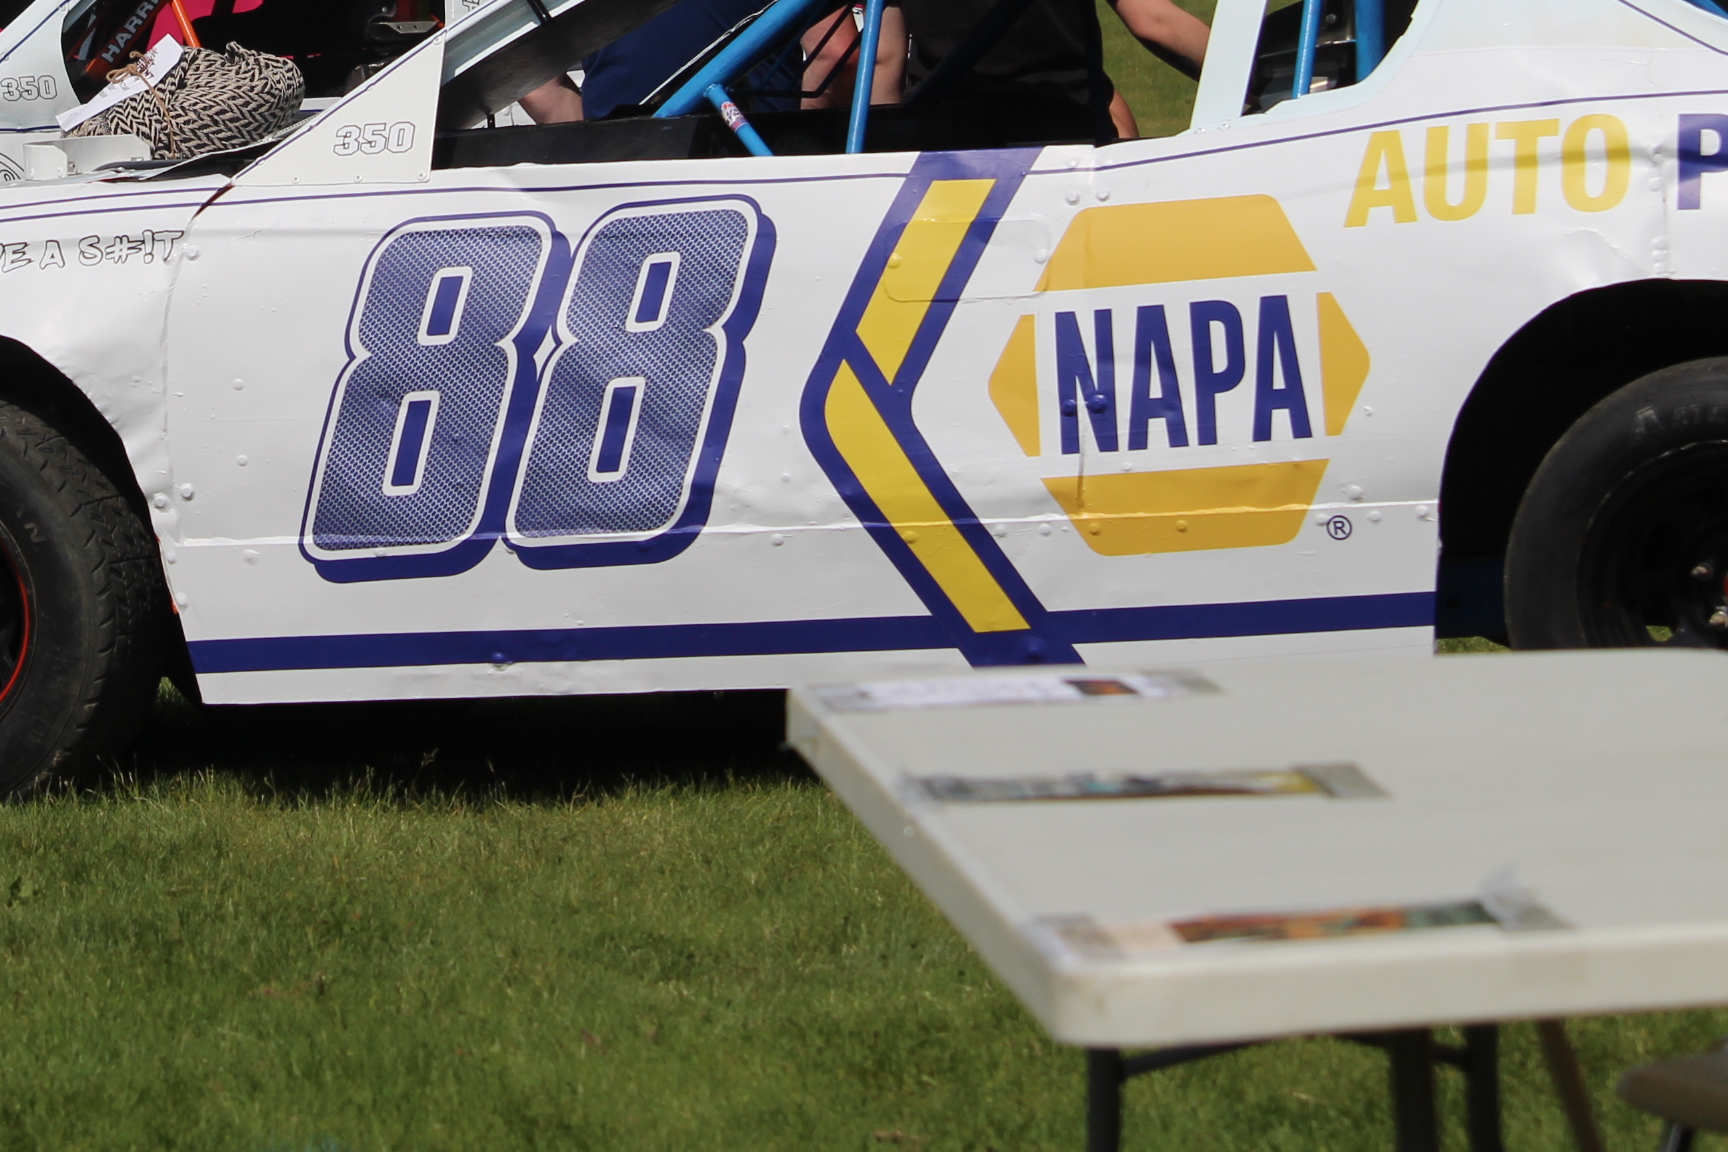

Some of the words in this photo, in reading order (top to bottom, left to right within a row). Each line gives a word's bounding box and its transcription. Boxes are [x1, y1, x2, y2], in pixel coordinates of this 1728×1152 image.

[0, 74, 58, 101] 350
[333, 121, 416, 156] 350
[1343, 114, 1631, 229] AUTO
[39, 240, 65, 268] A
[78, 230, 185, 267] S#!T
[298, 194, 778, 583] 88
[1055, 295, 1313, 456] NAPA
